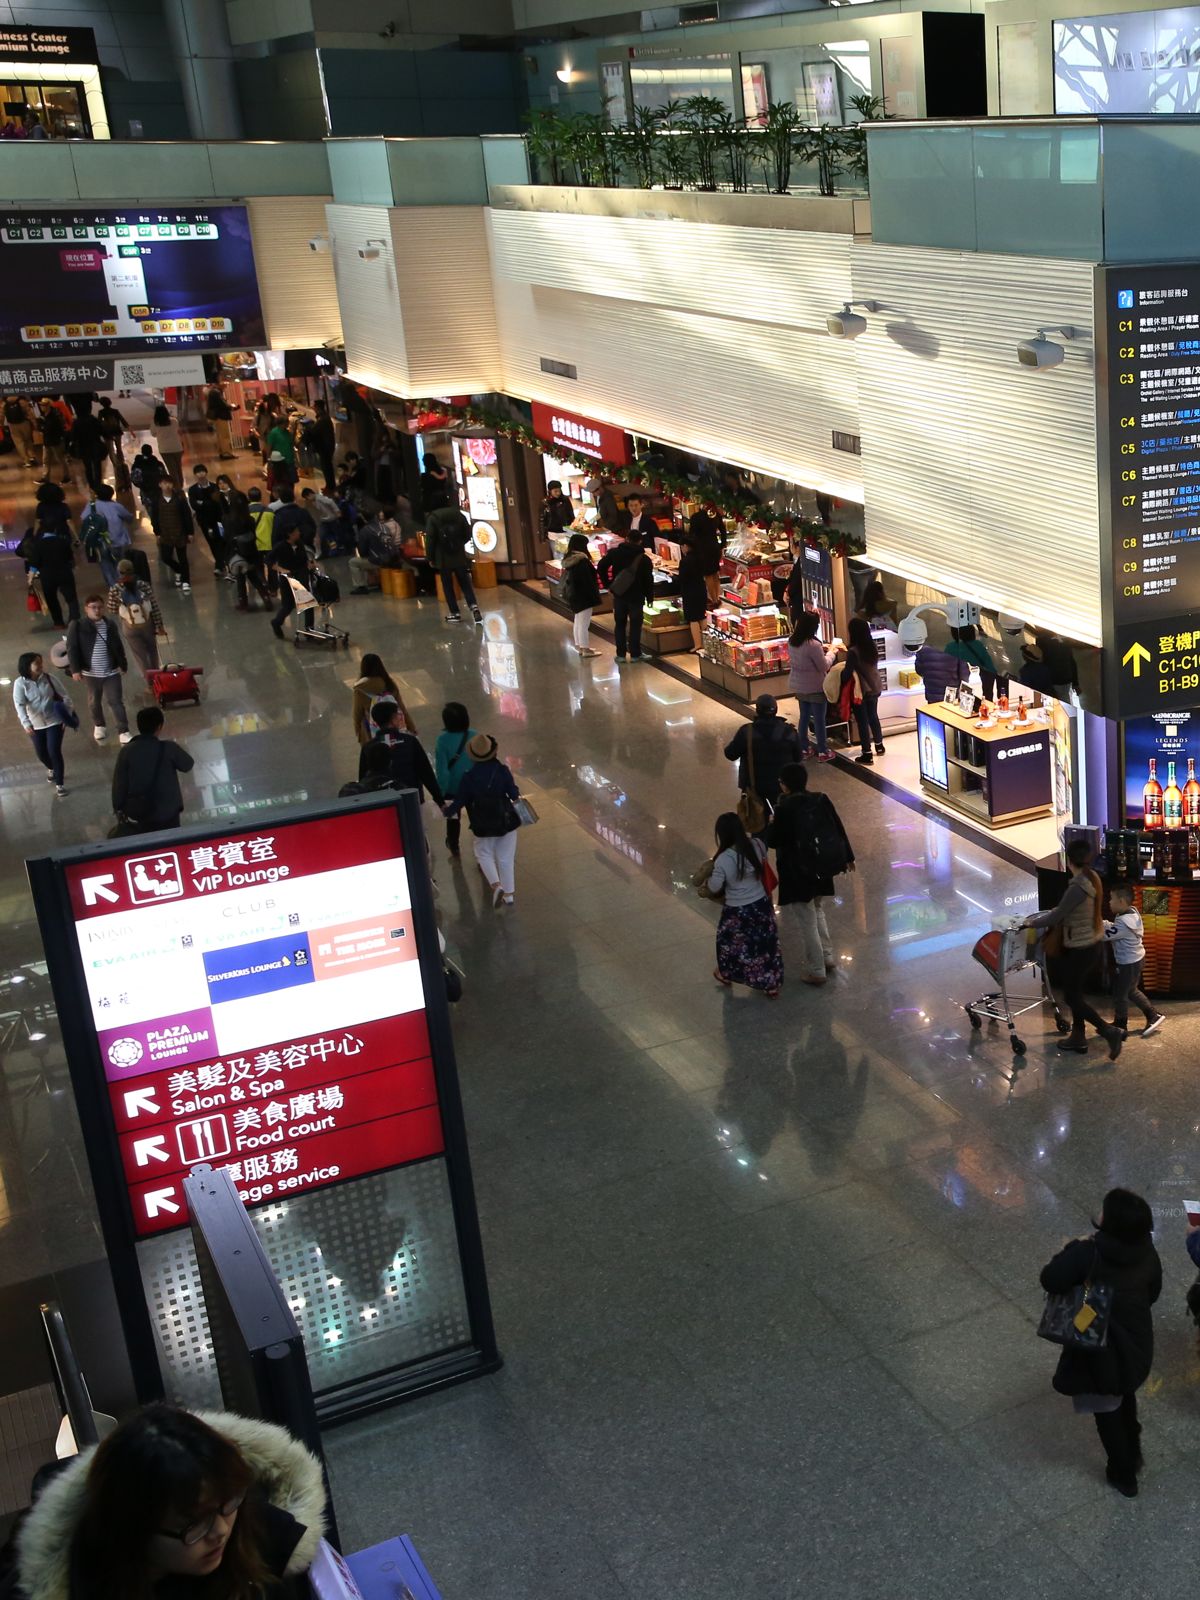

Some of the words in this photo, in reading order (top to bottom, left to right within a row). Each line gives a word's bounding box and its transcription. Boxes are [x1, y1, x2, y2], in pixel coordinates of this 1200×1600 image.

[31, 32, 66, 42] Center
[31, 44, 70, 54] Lounge
[1119, 320, 1132, 331] C1
[1120, 348, 1134, 358] C2
[1120, 374, 1134, 384] C3
[1120, 418, 1136, 428] C4
[1121, 444, 1135, 454] C5
[1122, 470, 1136, 481] C6
[1122, 496, 1136, 506] C7
[1123, 538, 1136, 548] C8
[1124, 562, 1137, 572] C9
[1124, 585, 1140, 596] C10
[1159, 674, 1199, 693] B1-B9
[188, 836, 278, 874] 貴賓室
[192, 875, 223, 893] VIP
[228, 864, 290, 886] lounge
[222, 898, 277, 918] CLUB
[207, 966, 249, 983] SILVERKRIS
[251, 961, 282, 974] LOUNGE
[147, 1024, 190, 1042] PLAZA
[148, 1030, 209, 1051] PREMIUM
[151, 1046, 189, 1061] LOUNGE
[168, 1033, 364, 1098] 美髮及美容中心
[172, 1093, 225, 1116] Salon
[230, 1087, 245, 1100] &
[250, 1079, 285, 1098] Spa
[233, 1086, 344, 1134] 美食廣場
[236, 1126, 284, 1151] Food
[288, 1116, 336, 1137] court
[216, 1148, 298, 1182] 摩服務
[278, 1166, 340, 1191] service
